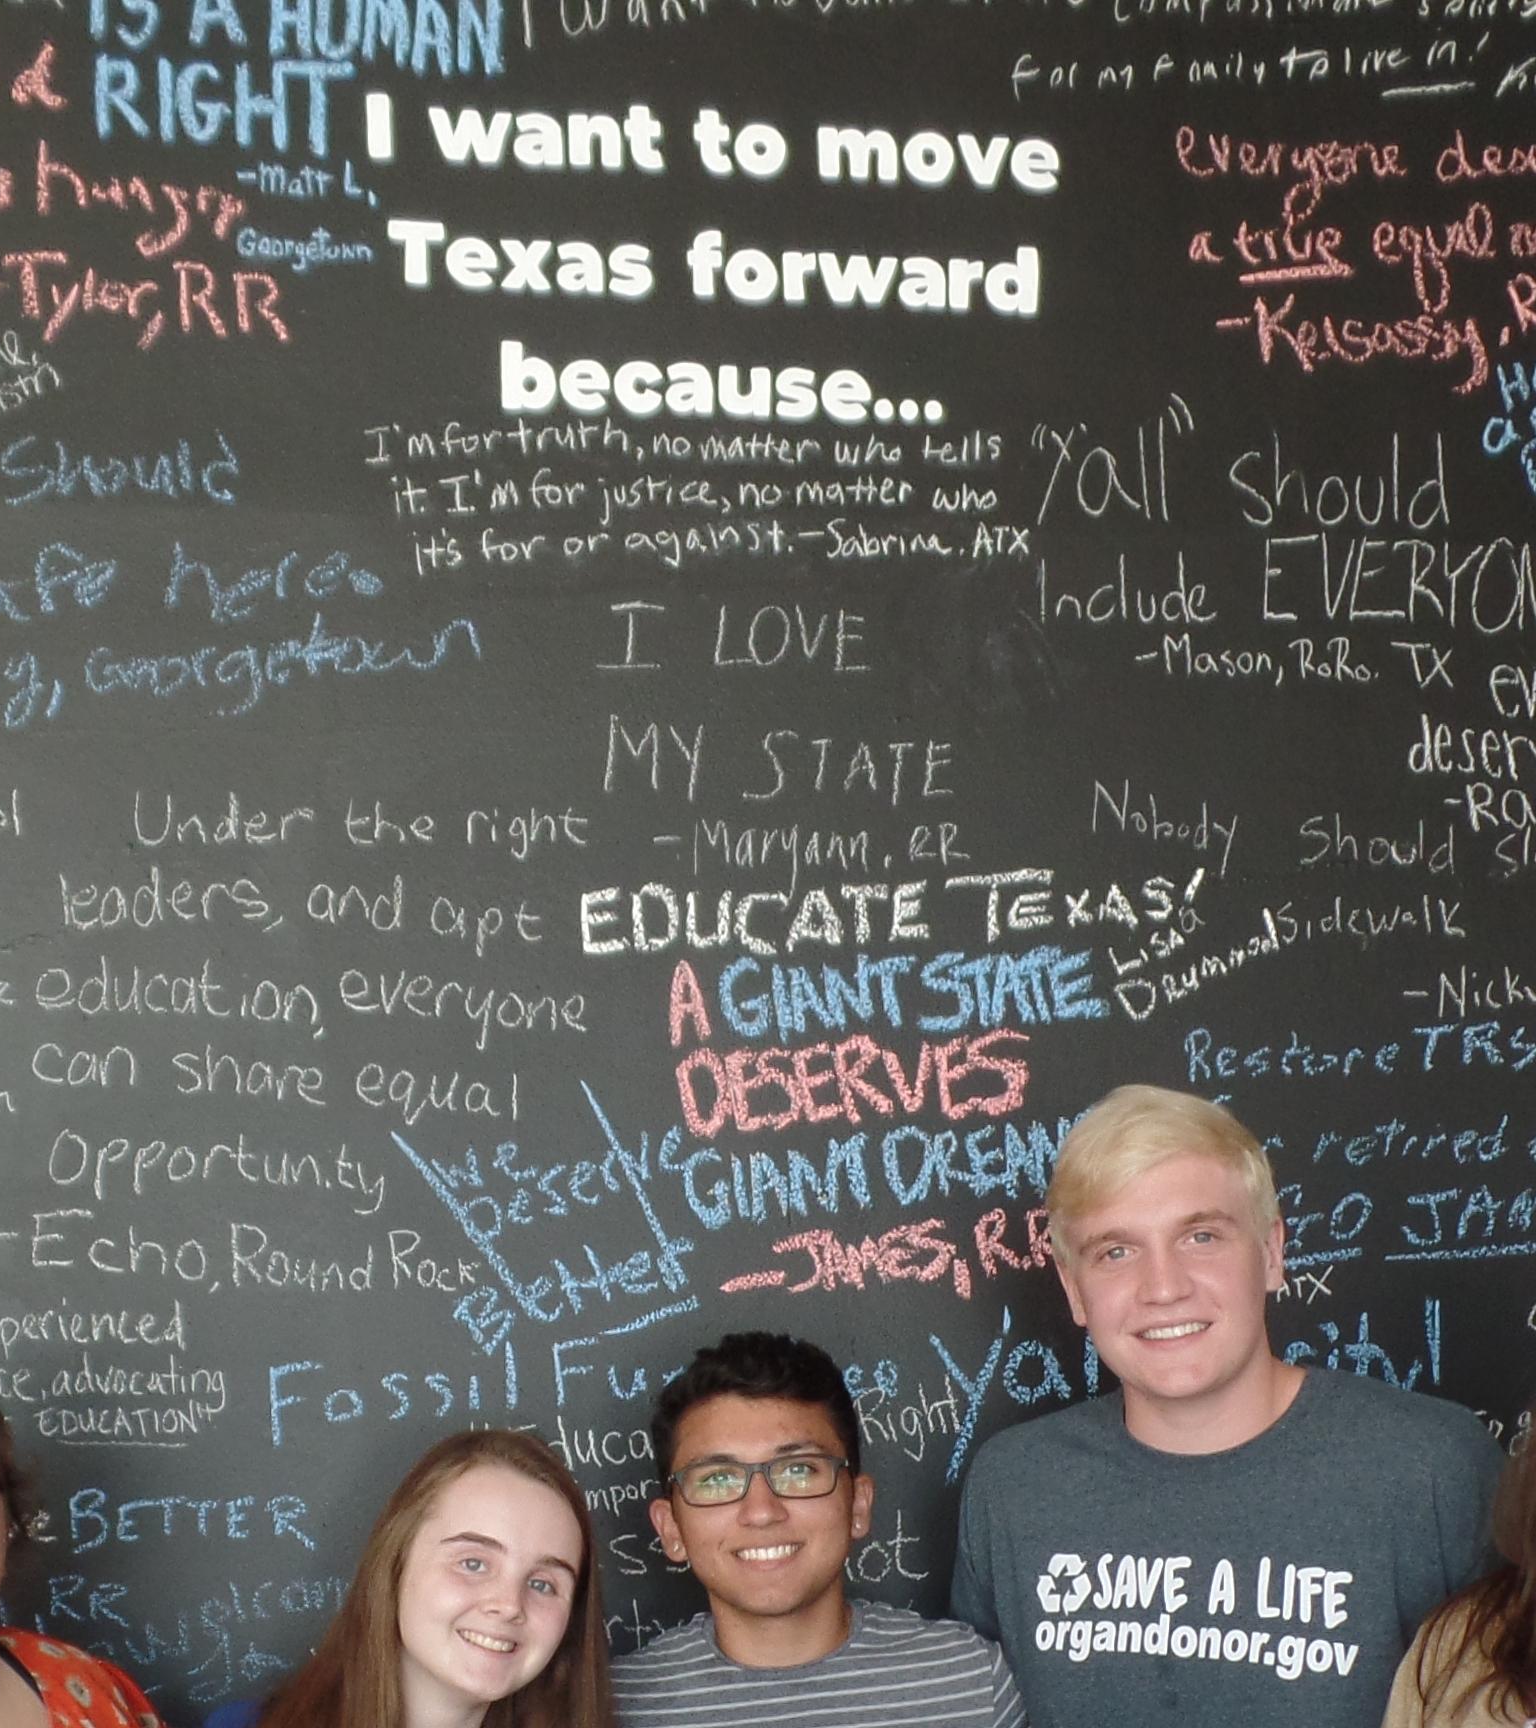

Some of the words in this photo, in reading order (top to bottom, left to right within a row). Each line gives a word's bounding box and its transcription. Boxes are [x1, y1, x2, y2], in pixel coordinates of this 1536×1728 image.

[94, 53, 357, 157] RIGHT
[364, 93, 394, 161] I
[429, 103, 664, 170] want
[692, 108, 787, 176] to
[817, 123, 1061, 191] move
[387, 217, 655, 300] Texas
[686, 229, 1041, 315] forward
[1189, 226, 1224, 263] a
[1232, 219, 1345, 268] true
[500, 340, 944, 422] because...
[651, 432, 693, 459] no
[698, 424, 822, 467] matter
[833, 430, 904, 466] who
[921, 433, 1002, 464] tells
[1482, 415, 1522, 454] a
[526, 465, 586, 507] for
[737, 479, 784, 508] no
[794, 475, 914, 508] matter
[931, 477, 999, 513] who
[479, 527, 546, 569] for
[562, 530, 608, 558] or
[971, 527, 1032, 557] ATX
[1036, 555, 1217, 625] Include
[595, 599, 664, 670] I
[713, 602, 871, 672] LOVE
[1390, 642, 1457, 688] TX
[603, 714, 705, 799] MY
[742, 728, 956, 806] STATE
[134, 789, 314, 846] Under
[344, 798, 434, 844] the
[465, 805, 589, 860] right
[1094, 779, 1239, 877] Nobody
[306, 874, 403, 931] and
[578, 879, 930, 954] EDUCATE
[338, 964, 589, 1052] everyone
[669, 959, 713, 1046] A
[719, 952, 915, 1043] GIANT
[917, 943, 1111, 1034] STATE
[31, 1043, 136, 1090] can
[171, 1045, 326, 1107] share
[355, 1056, 520, 1126] equal
[673, 1029, 1031, 1140] DESERVES
[683, 1132, 870, 1230] GIANT
[230, 1222, 373, 1290] Round
[388, 1229, 476, 1290] Rock
[53, 1353, 225, 1411] advocating
[267, 1340, 517, 1446] Fossil
[1093, 1554, 1192, 1612] SAVE
[1208, 1559, 1235, 1614] A
[1257, 1557, 1353, 1629] LIFE
[1035, 1614, 1359, 1680] organdonor.gov
